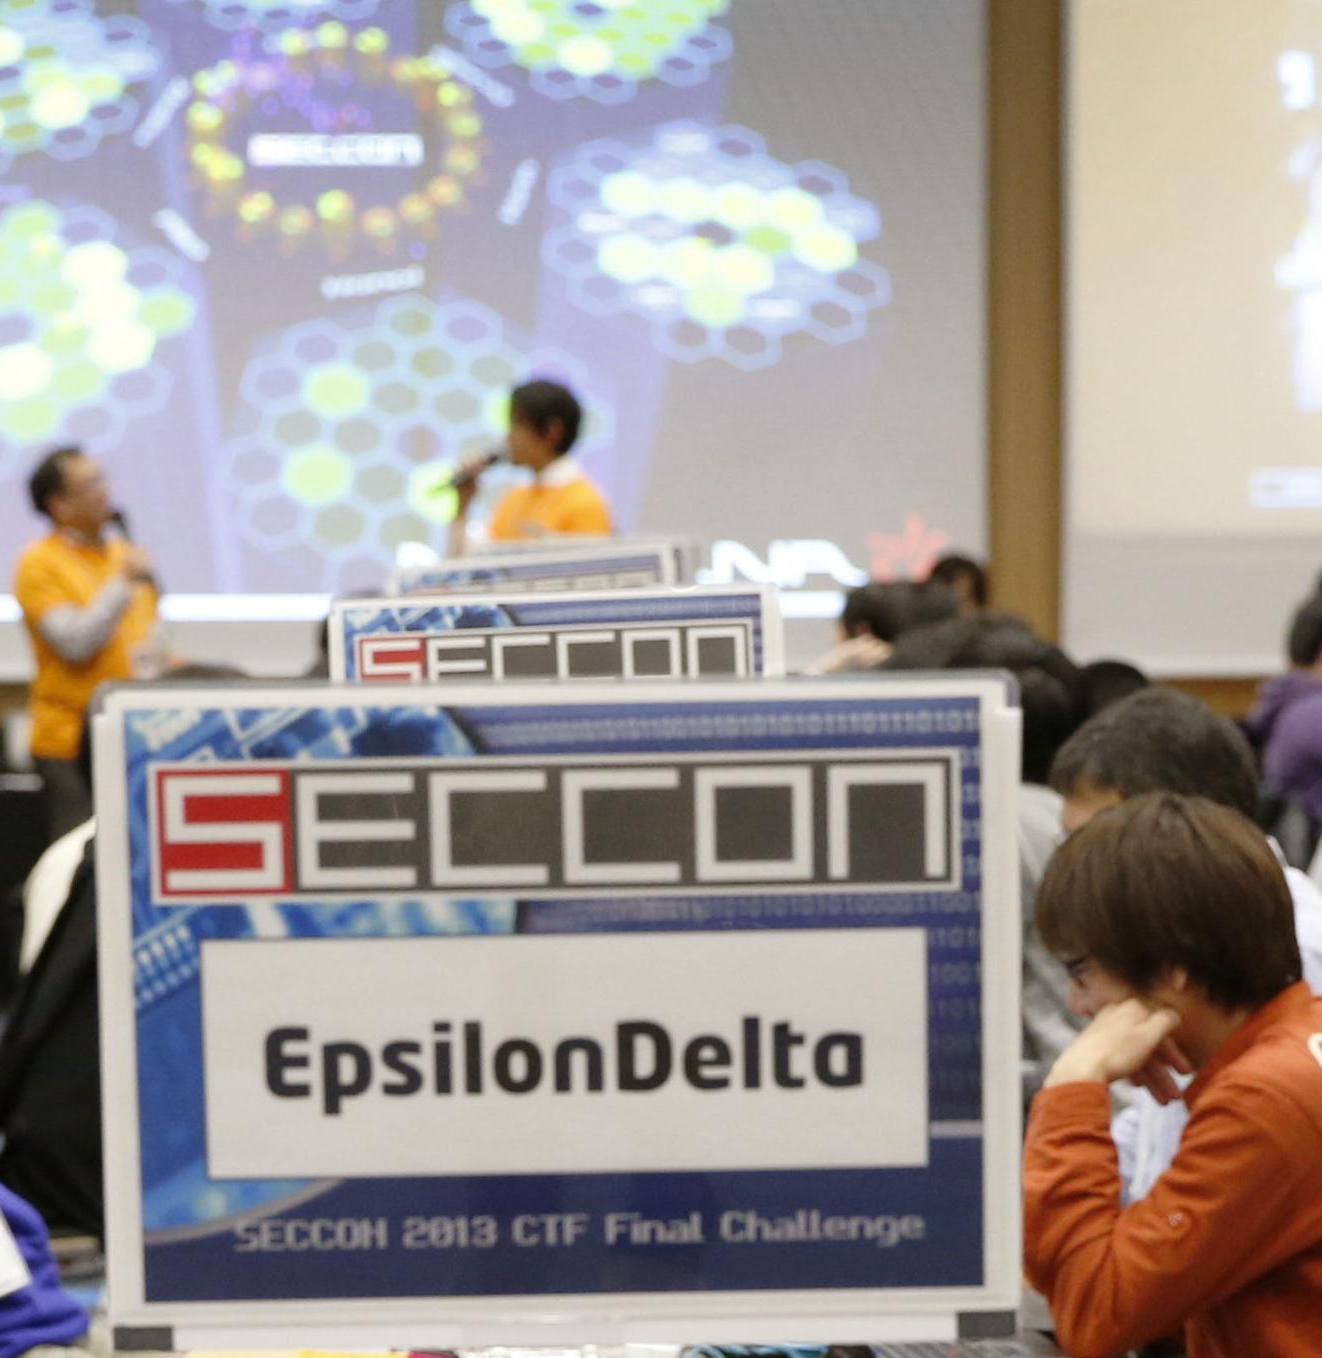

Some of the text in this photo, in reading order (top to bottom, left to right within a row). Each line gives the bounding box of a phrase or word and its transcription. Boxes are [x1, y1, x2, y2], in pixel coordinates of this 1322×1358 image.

[161, 762, 947, 892] SECCON
[264, 1016, 864, 1115] EpsilonDelta
[402, 1214, 498, 1249] 2013
[511, 1212, 588, 1247] CTF
[604, 1209, 705, 1246] Final
[718, 1207, 925, 1248] Challenge
